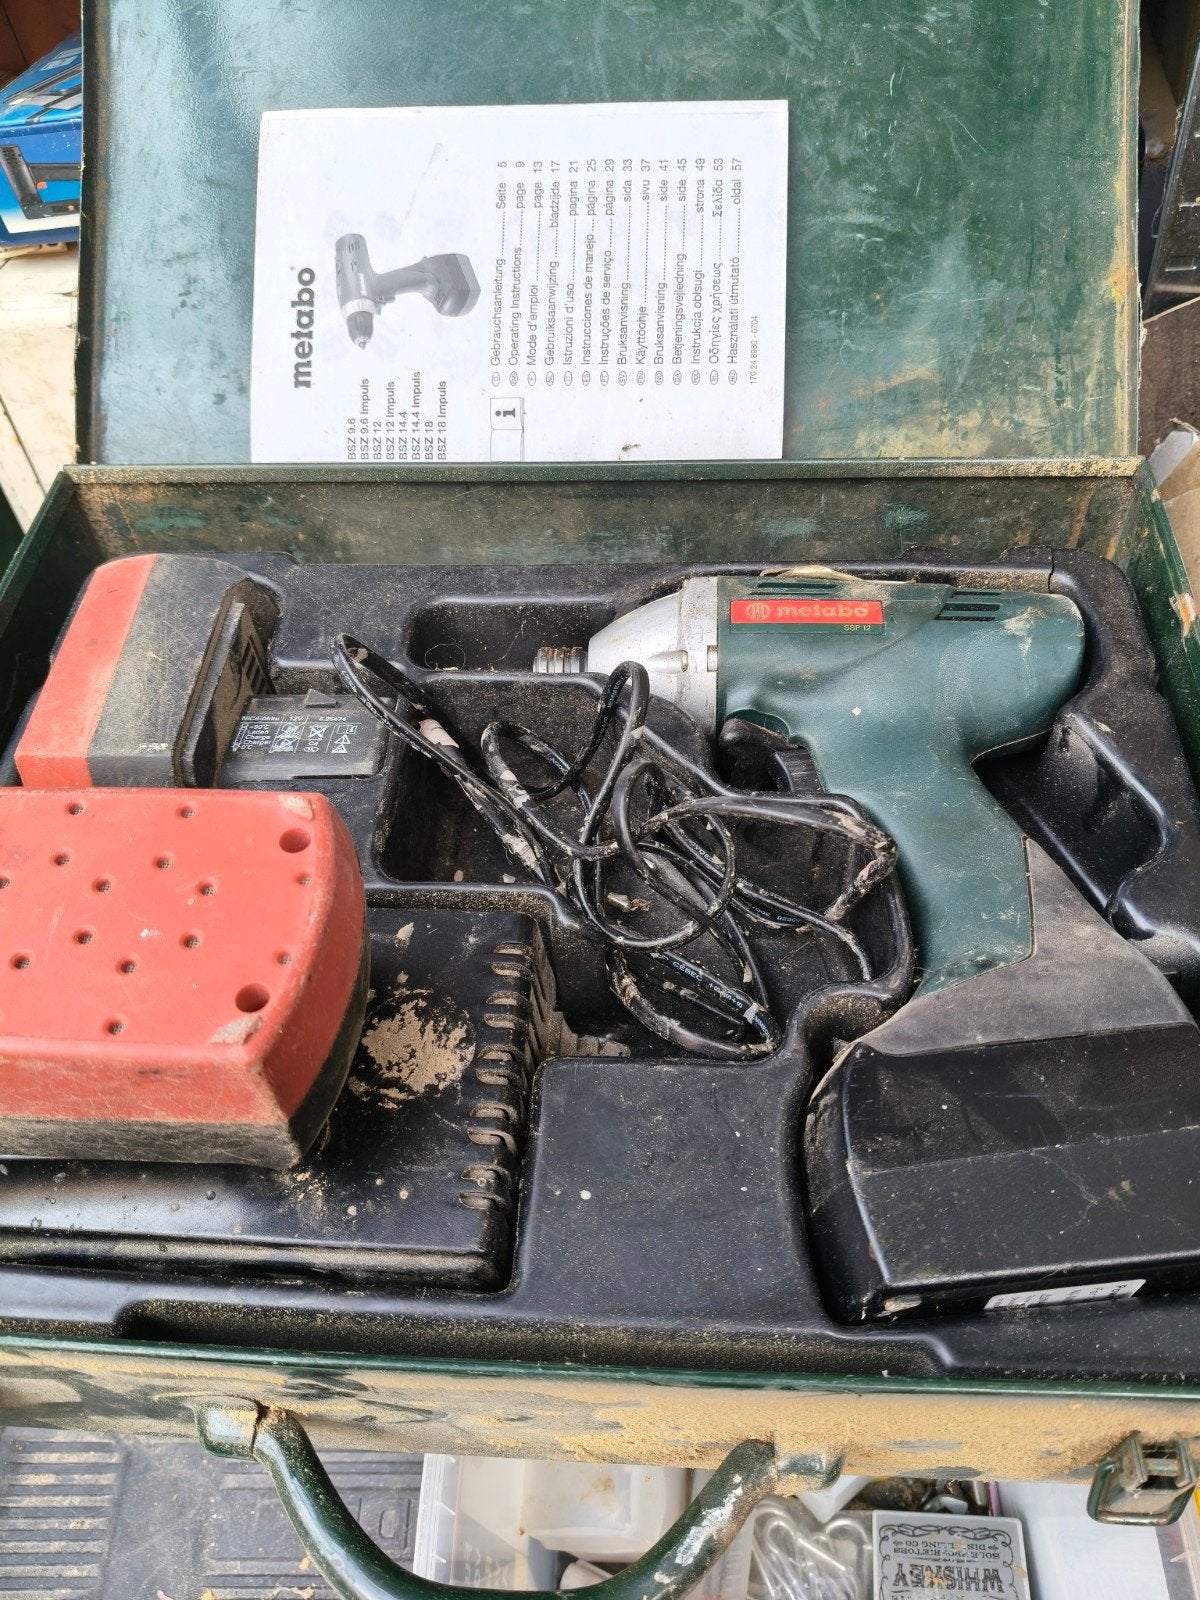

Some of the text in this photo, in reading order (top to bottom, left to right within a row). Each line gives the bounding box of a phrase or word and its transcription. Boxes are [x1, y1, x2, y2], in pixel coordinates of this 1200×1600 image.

[533, 160, 543, 174] 13
[550, 160, 560, 174] 17
[568, 161, 578, 173] 21
[586, 158, 597, 172] 25
[604, 158, 615, 172] 29
[622, 158, 633, 172] 33
[640, 158, 651, 172] 37
[658, 160, 669, 172] 41
[676, 158, 688, 172] 45
[695, 158, 706, 172] 49
[713, 157, 724, 171] 53
[731, 157, 742, 171] 57
[495, 182, 507, 210] Seite
[516, 182, 526, 209] page
[534, 182, 544, 208] page
[548, 181, 562, 228] bladzijde
[569, 180, 580, 216] pagina
[584, 180, 598, 216] página
[603, 179, 616, 216] página
[622, 180, 632, 202] sida
[640, 179, 650, 201] sivu
[658, 179, 669, 202] side
[676, 179, 687, 202] side
[694, 179, 705, 213] strona
[730, 179, 742, 205] oldal
[584, 233, 596, 273] manejo
[601, 250, 614, 288] serviço
[510, 247, 522, 309] Instructions
[583, 275, 593, 290] de
[728, 256, 740, 305] útmutató
[490, 258, 506, 366] Gebrauchsanleitung
[527, 284, 539, 332] d'emploi
[544, 261, 560, 366] Gebruiksaanwijzing
[564, 283, 575, 314] d'uso
[600, 291, 611, 306] de
[672, 253, 688, 364] Betjeningsvejledning
[290, 268, 316, 388] metabo
[508, 312, 522, 366] Operating
[562, 316, 574, 366] Istruzioni
[580, 292, 593, 365] Instrucciones
[598, 308, 612, 365] Instruções
[616, 282, 632, 365] Bruksanvisning
[635, 305, 648, 365] Käyttöohje
[653, 282, 668, 365] Bruksanvisning
[690, 311, 704, 364] Instrukcja
[727, 308, 739, 364] Használati
[526, 334, 537, 366] Mode
[750, 360, 757, 369] 24
[359, 378, 371, 460] BSZ 9.6 Impuls
[385, 381, 396, 460] BSZ 12 Impuls
[411, 371, 422, 460] BSZ 14.4 Impuls
[437, 380, 448, 460] BSZ 18 Impuls
[347, 417, 356, 460] BSZ 9.6
[372, 421, 382, 460] BSZ 12
[398, 411, 408, 460] BSZ 14.4
[424, 420, 434, 460] BSZ 18
[778, 604, 868, 617] metabo
[892, 1563, 1004, 1593] WHISKEY
